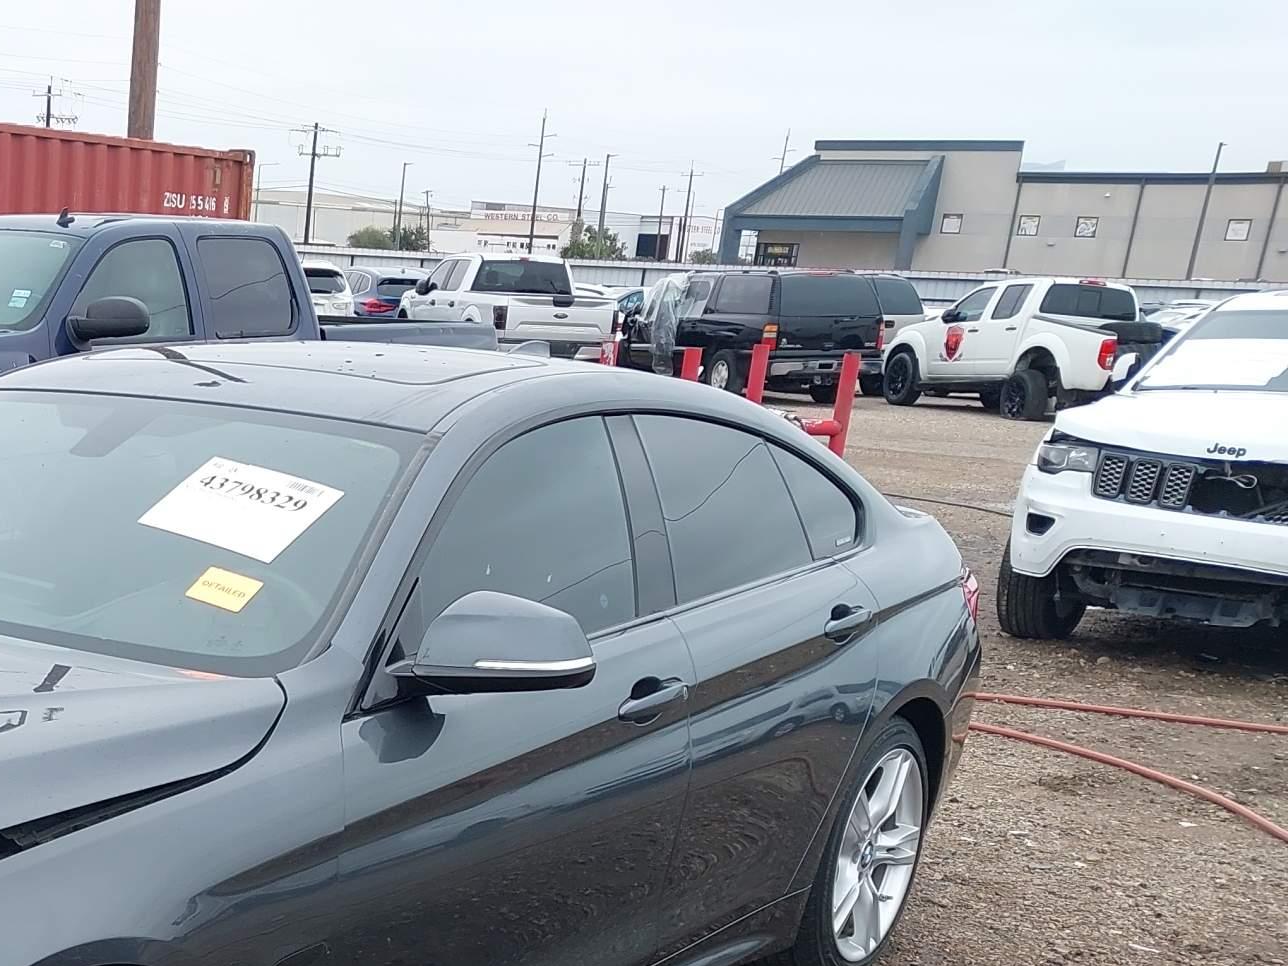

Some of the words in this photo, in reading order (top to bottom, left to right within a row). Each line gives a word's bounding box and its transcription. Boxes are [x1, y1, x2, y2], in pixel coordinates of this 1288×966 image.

[484, 212, 518, 221] WESTERN
[1206, 443, 1247, 458] Jeep
[200, 475, 308, 511] 43798329
[201, 579, 246, 599] DETAILED
